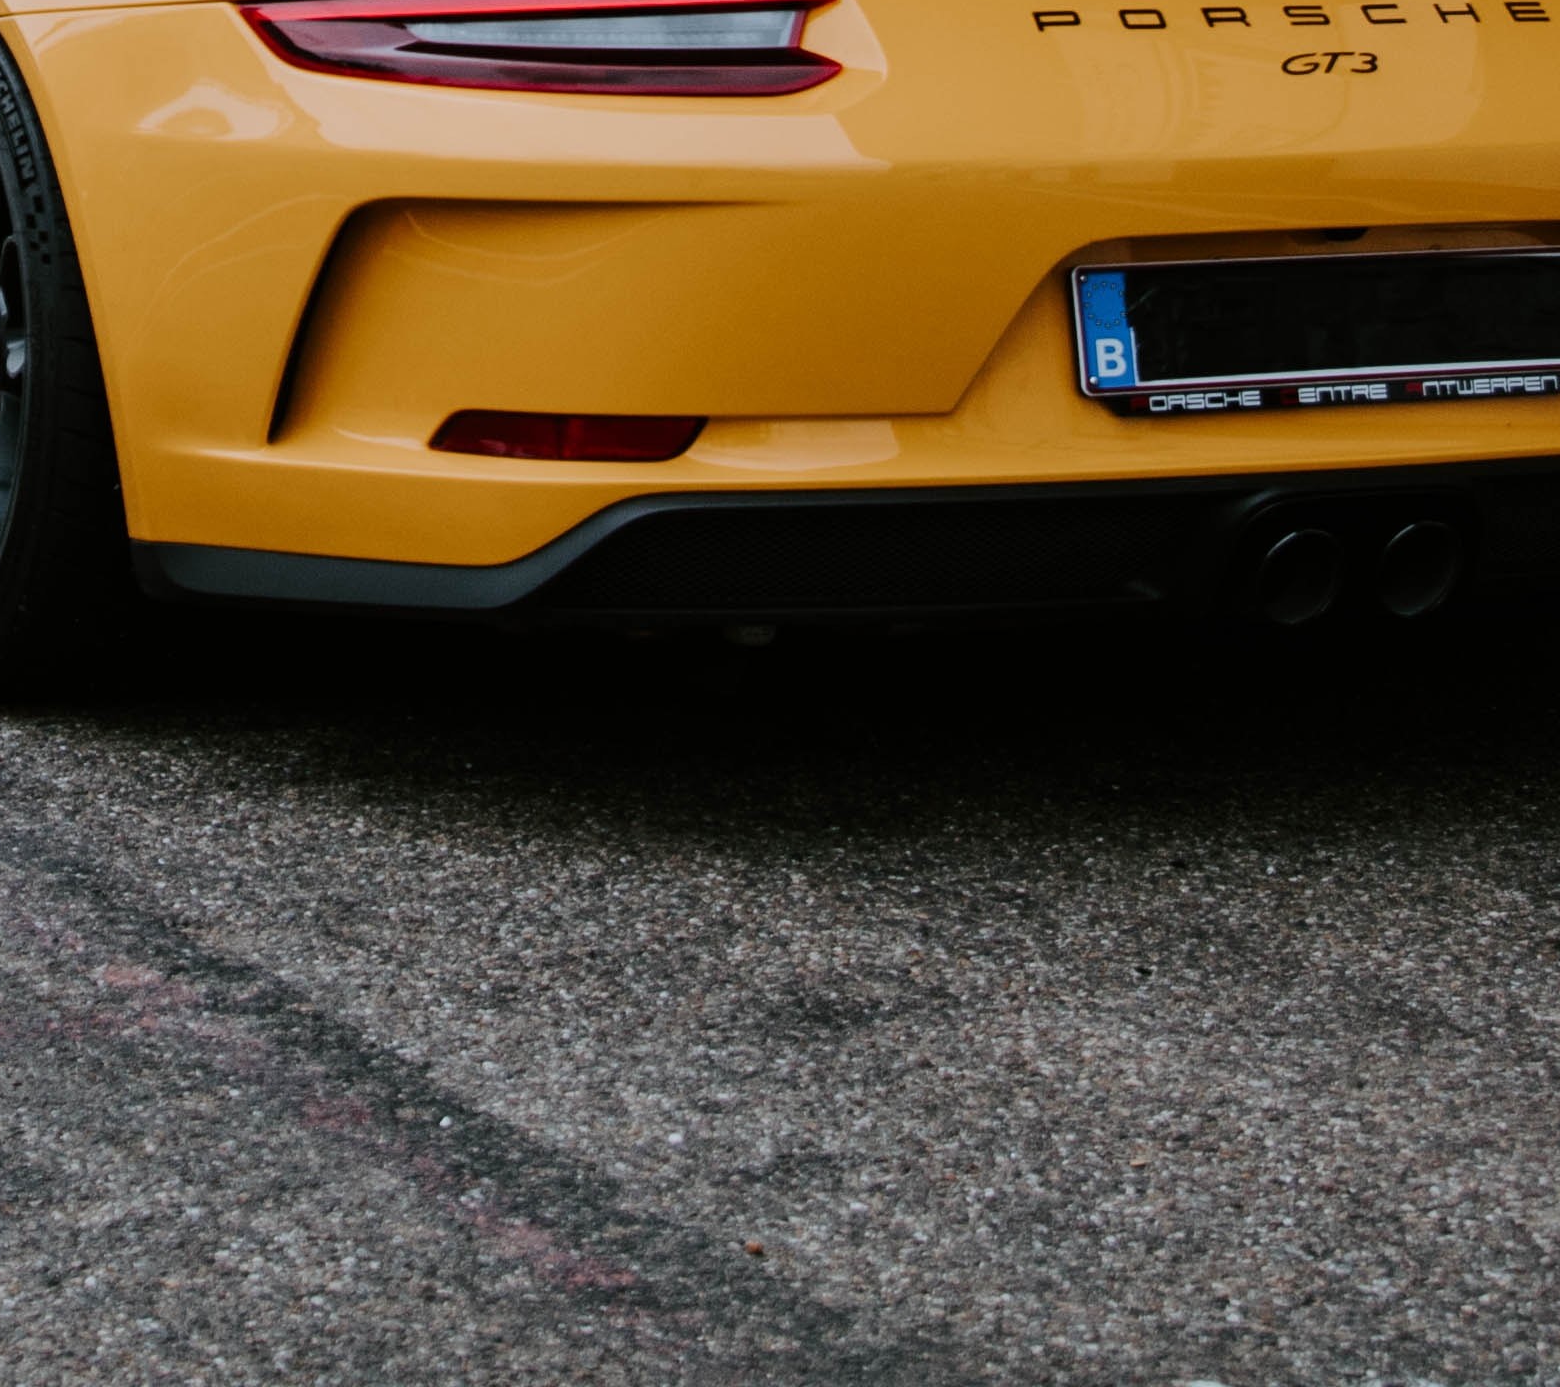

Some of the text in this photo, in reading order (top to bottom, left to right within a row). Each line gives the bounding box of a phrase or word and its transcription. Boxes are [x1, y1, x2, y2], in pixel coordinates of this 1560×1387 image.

[1031, 1, 1551, 33] PORSCHE
[1281, 51, 1379, 76] GT3
[1094, 337, 1128, 378] B
[1129, 375, 1558, 412] PORSCHE CENTRE ANTWERPEN
